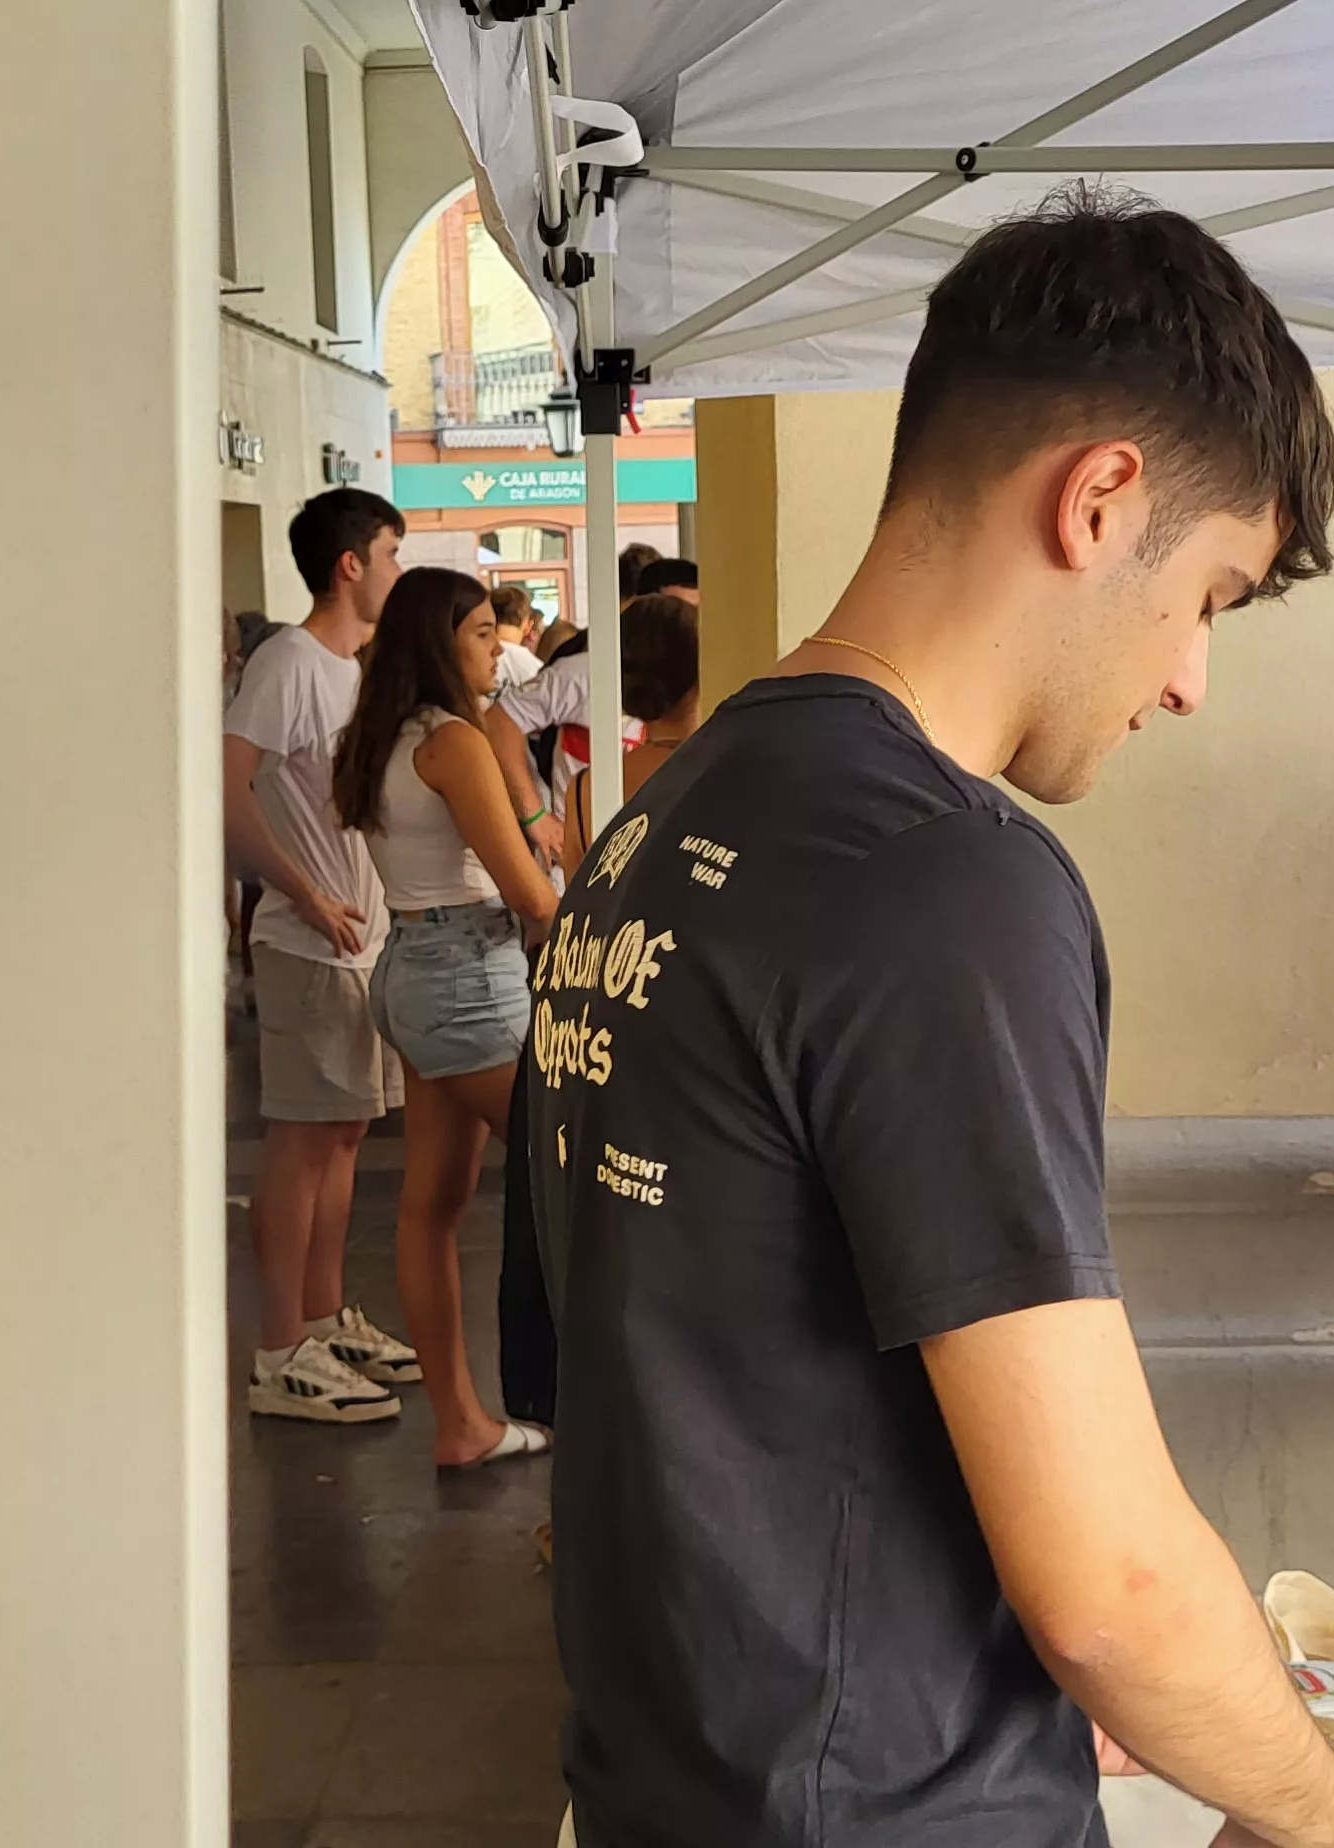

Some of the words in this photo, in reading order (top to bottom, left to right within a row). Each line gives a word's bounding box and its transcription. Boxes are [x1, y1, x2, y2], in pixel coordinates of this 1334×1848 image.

[499, 472, 537, 487] CAJA
[510, 489, 526, 500] DE
[678, 834, 739, 868] NATURE
[690, 861, 727, 890] WAR
